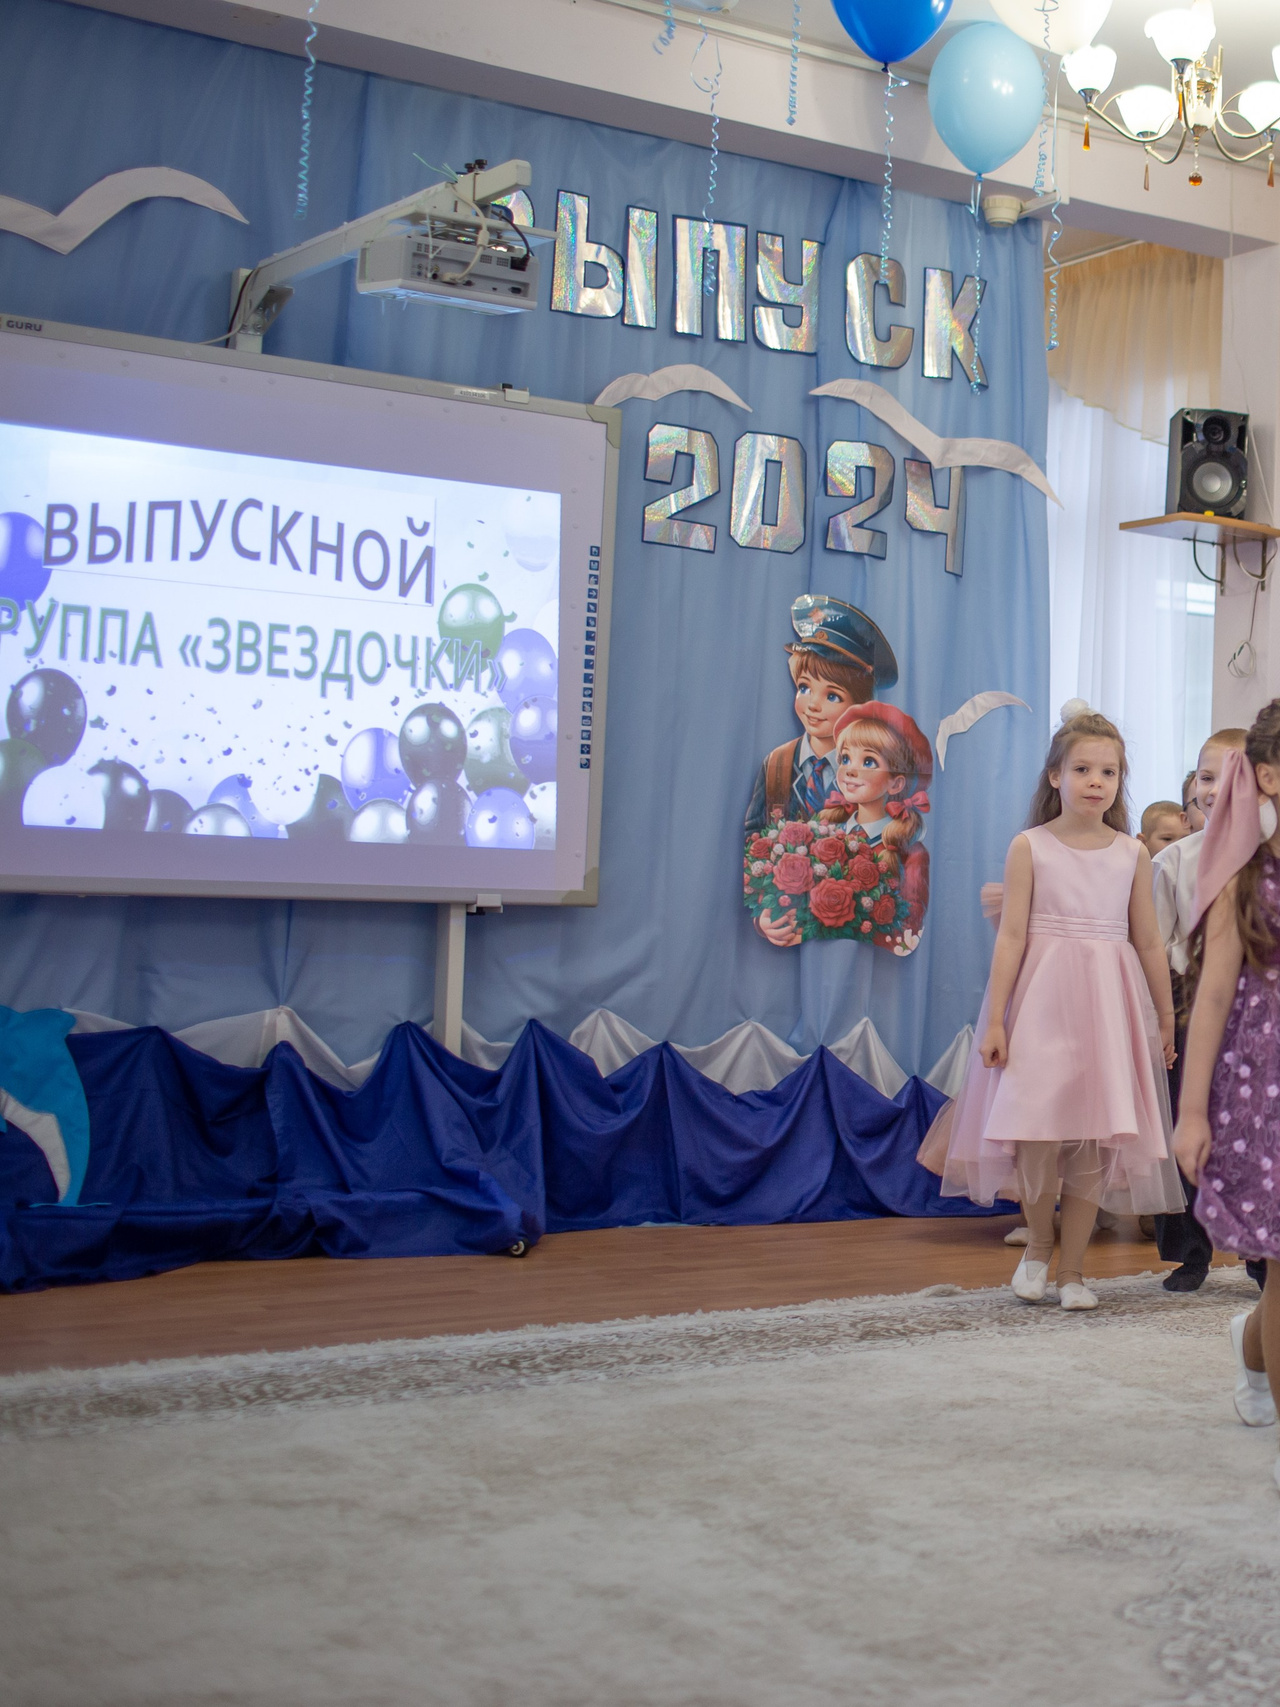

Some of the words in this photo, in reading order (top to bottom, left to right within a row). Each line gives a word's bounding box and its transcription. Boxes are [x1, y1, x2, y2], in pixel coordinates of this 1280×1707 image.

[6, 319, 43, 332] GURU
[642, 422, 965, 577] 2024
[42, 498, 436, 604] ВЫПУСКНОЙ
[178, 617, 508, 700] «ЗВЕЗДОЧКИ»
